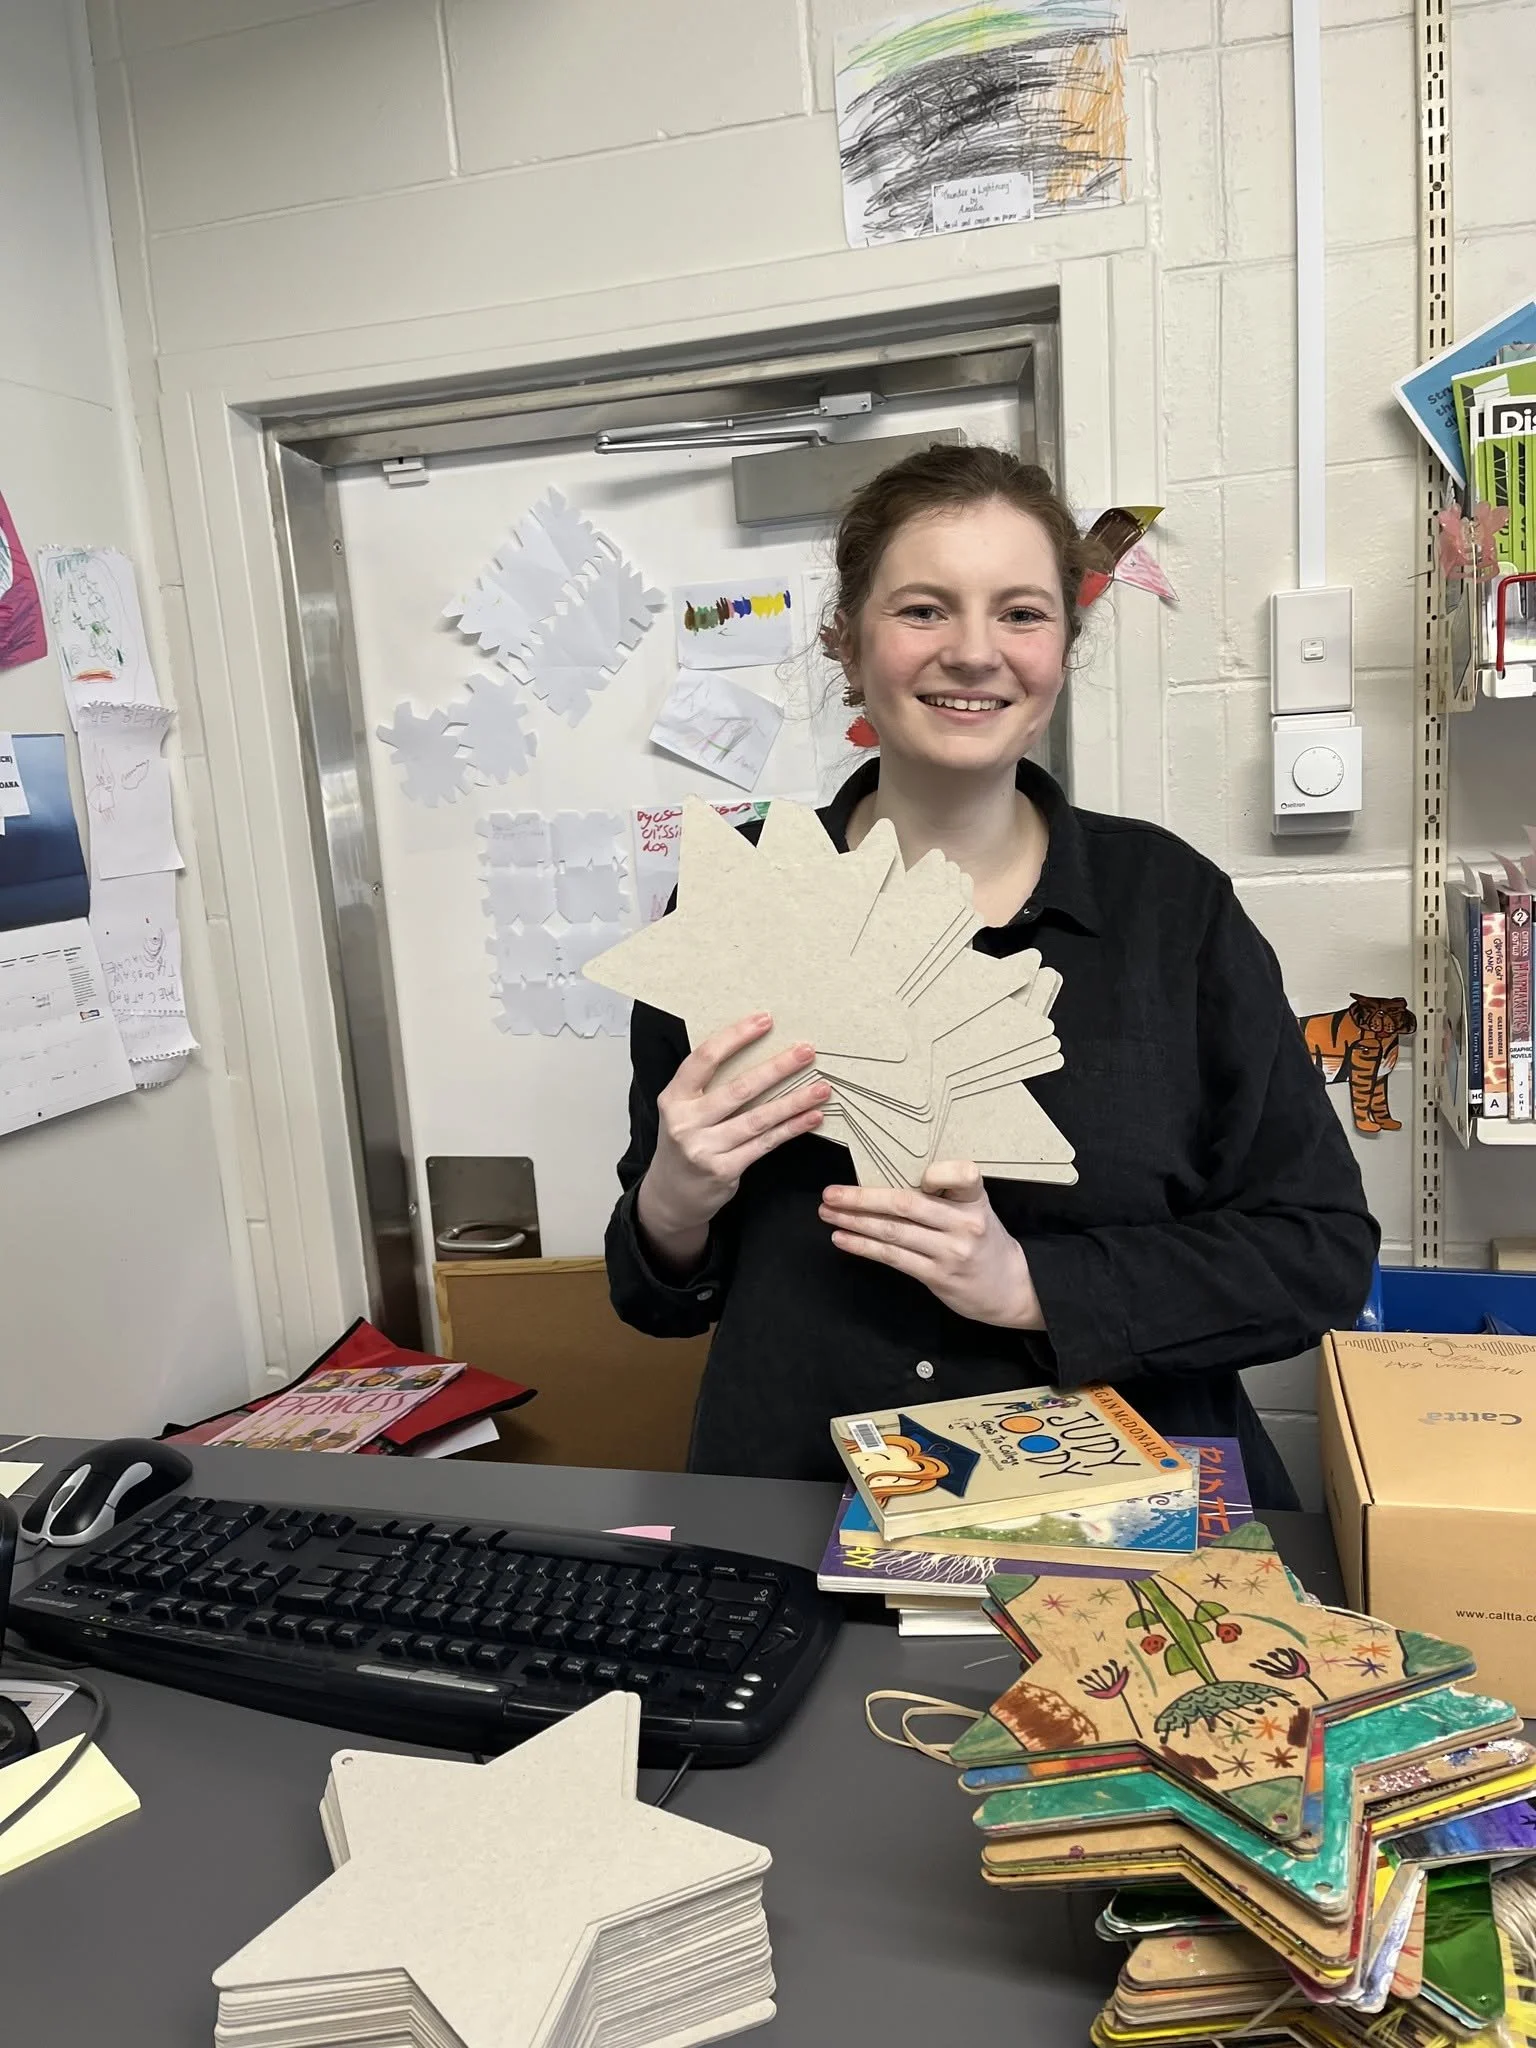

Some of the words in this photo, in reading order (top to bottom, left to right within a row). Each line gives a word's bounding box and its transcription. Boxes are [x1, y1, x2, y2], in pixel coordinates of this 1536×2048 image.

[1516, 911, 1524, 923] 2
[1485, 948, 1494, 974] DANCE
[1511, 960, 1531, 1035] MAPMAKERS
[1509, 1046, 1532, 1054] GRAPHIC
[1490, 1098, 1500, 1109] A
[259, 1391, 418, 1416] PRINCESS
[1090, 1385, 1120, 1410] EGAN
[1111, 1409, 1168, 1459] McDONALD
[1426, 1412, 1523, 1426] Caltta
[981, 1401, 1093, 1479] MOODY
[1046, 1411, 1142, 1469] JUDY
